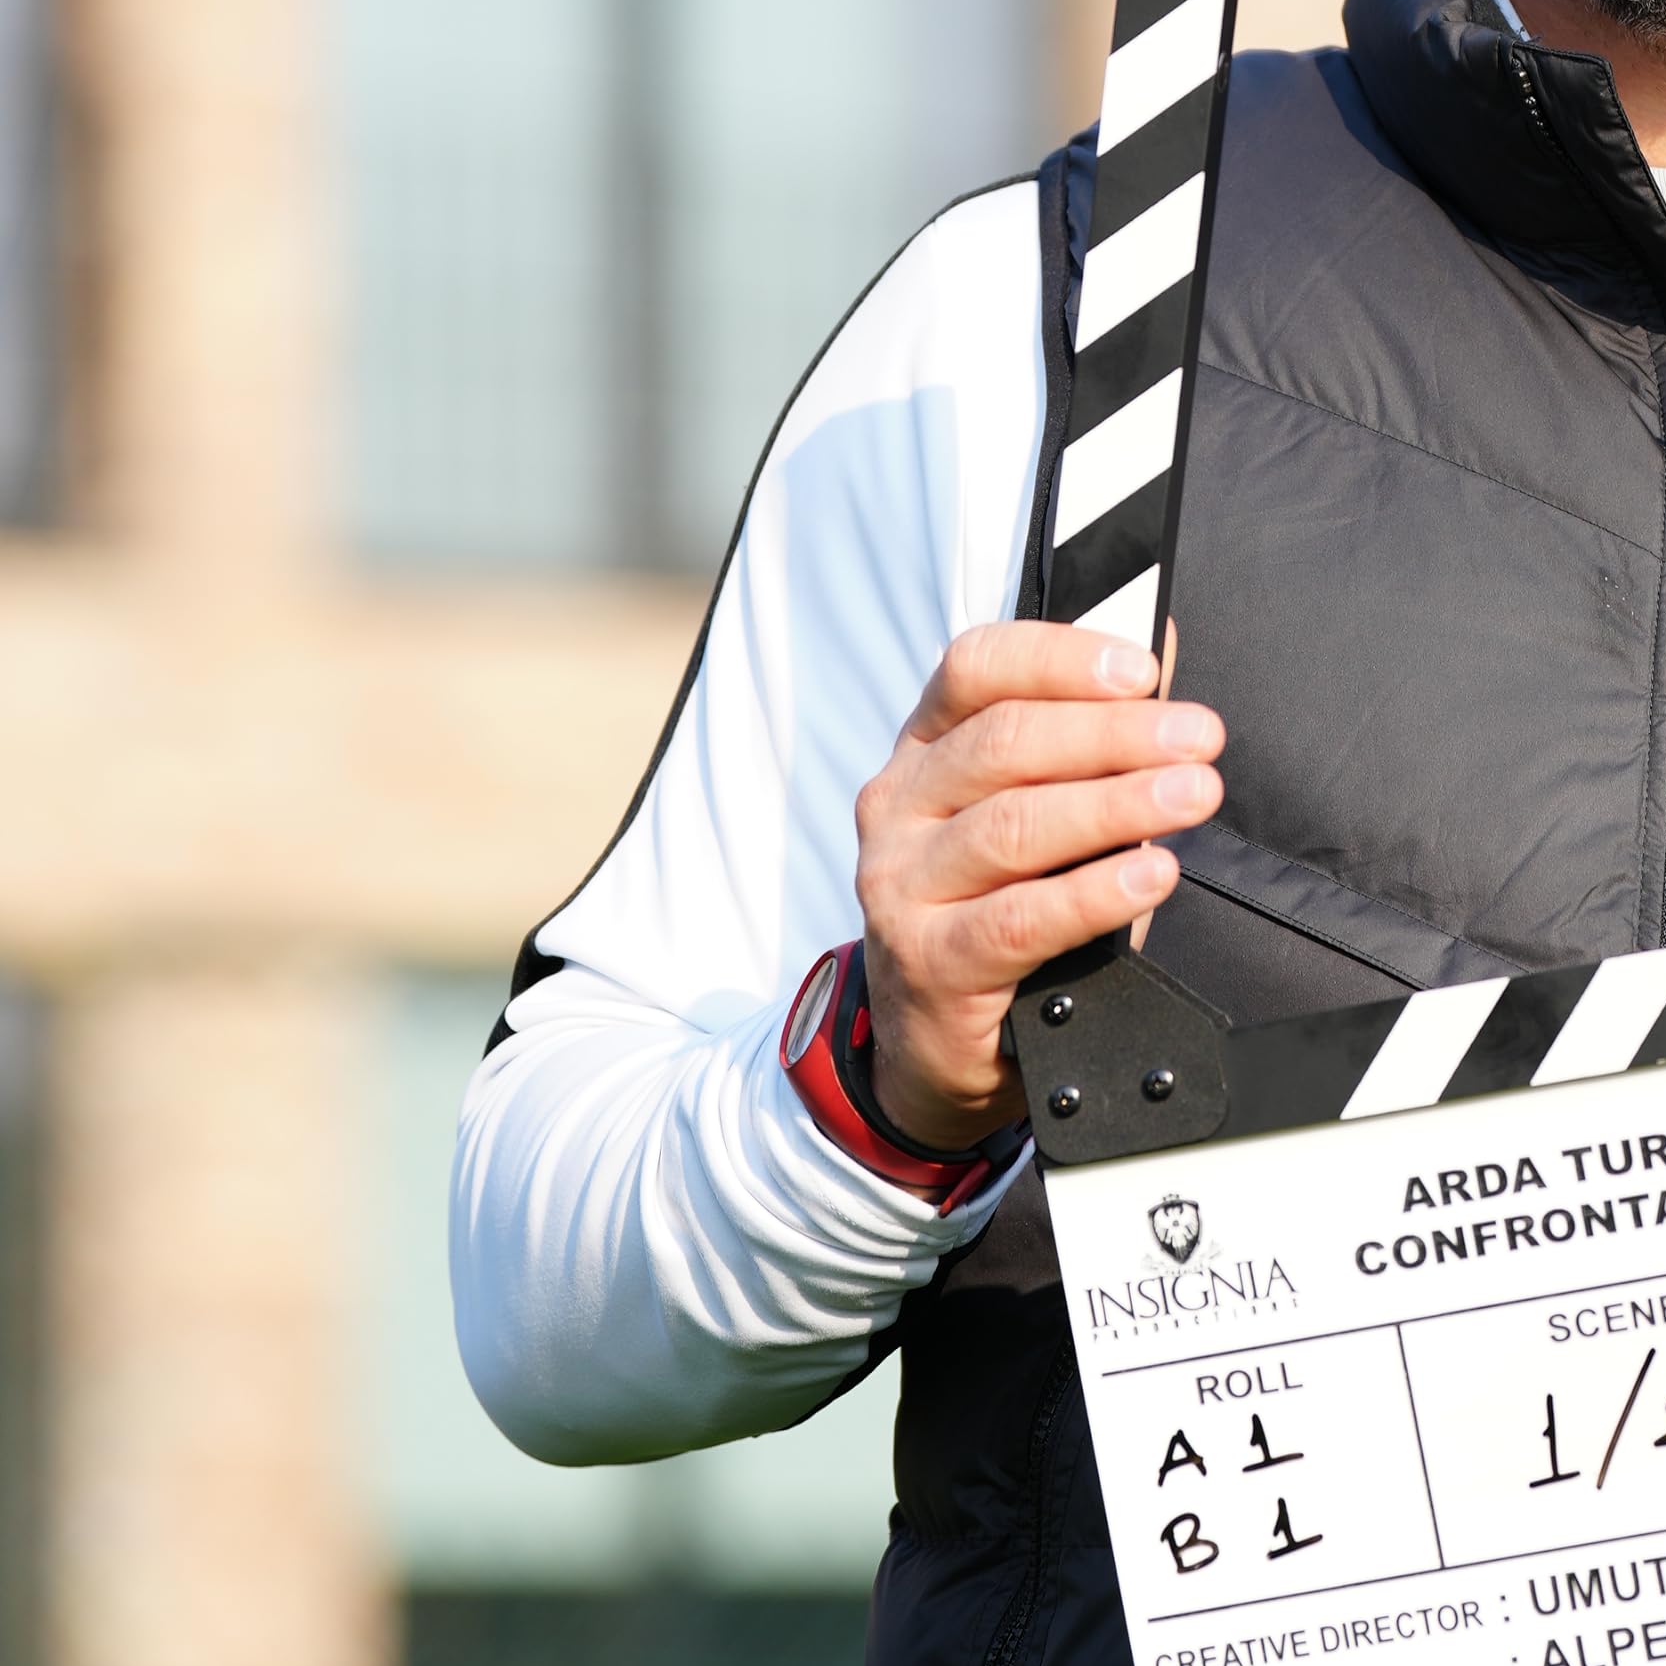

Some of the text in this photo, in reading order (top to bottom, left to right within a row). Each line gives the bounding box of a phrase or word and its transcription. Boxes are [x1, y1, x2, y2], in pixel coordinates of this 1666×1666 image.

[1402, 1156, 1548, 1214] ARDA
[1085, 1256, 1298, 1329] INSIGNIA
[1195, 1362, 1304, 1405] ROLL
[1157, 1412, 1305, 1488] A 1
[1159, 1496, 1324, 1575] B 1
[1319, 1601, 1483, 1653] DIRECTOR
